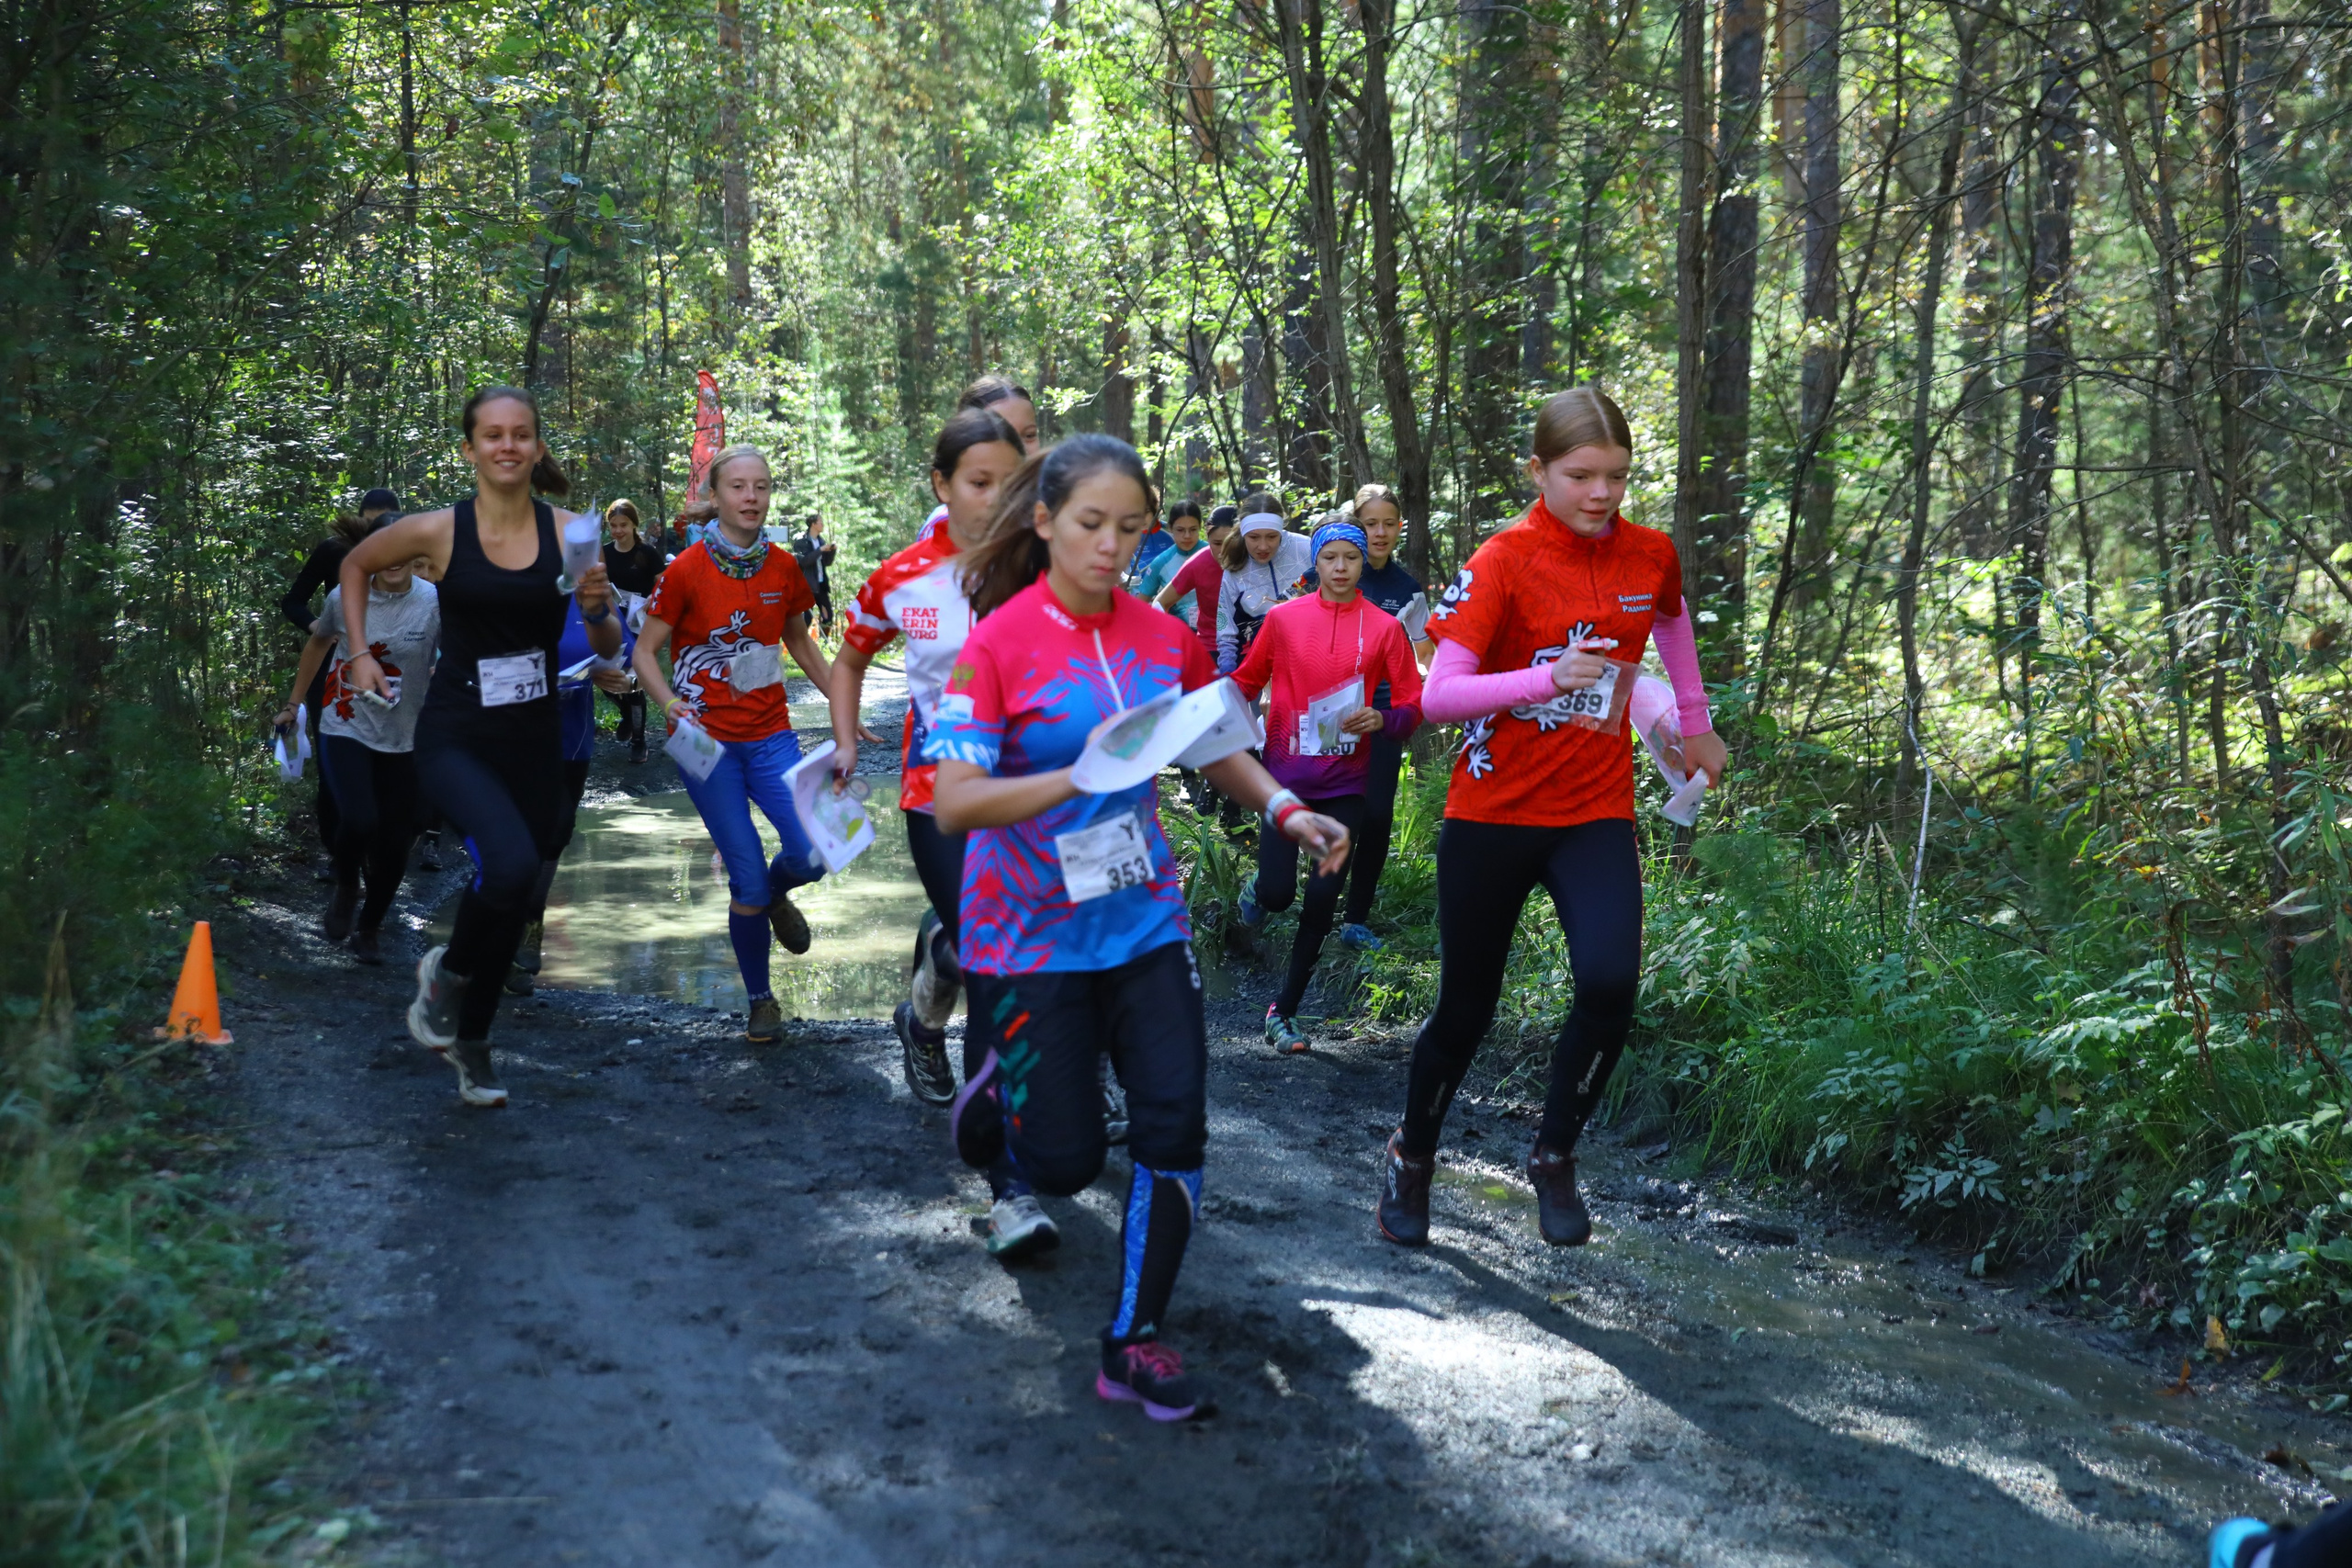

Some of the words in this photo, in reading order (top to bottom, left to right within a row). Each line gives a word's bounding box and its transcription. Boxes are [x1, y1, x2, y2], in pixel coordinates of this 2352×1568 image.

[1618, 593, 1653, 603] Бакунина
[902, 607, 939, 617] EKAT
[902, 618, 939, 628] ERIN
[905, 629, 938, 640] URG
[514, 678, 545, 700] 371
[1557, 693, 1603, 715] 369
[1106, 854, 1149, 892] 353
